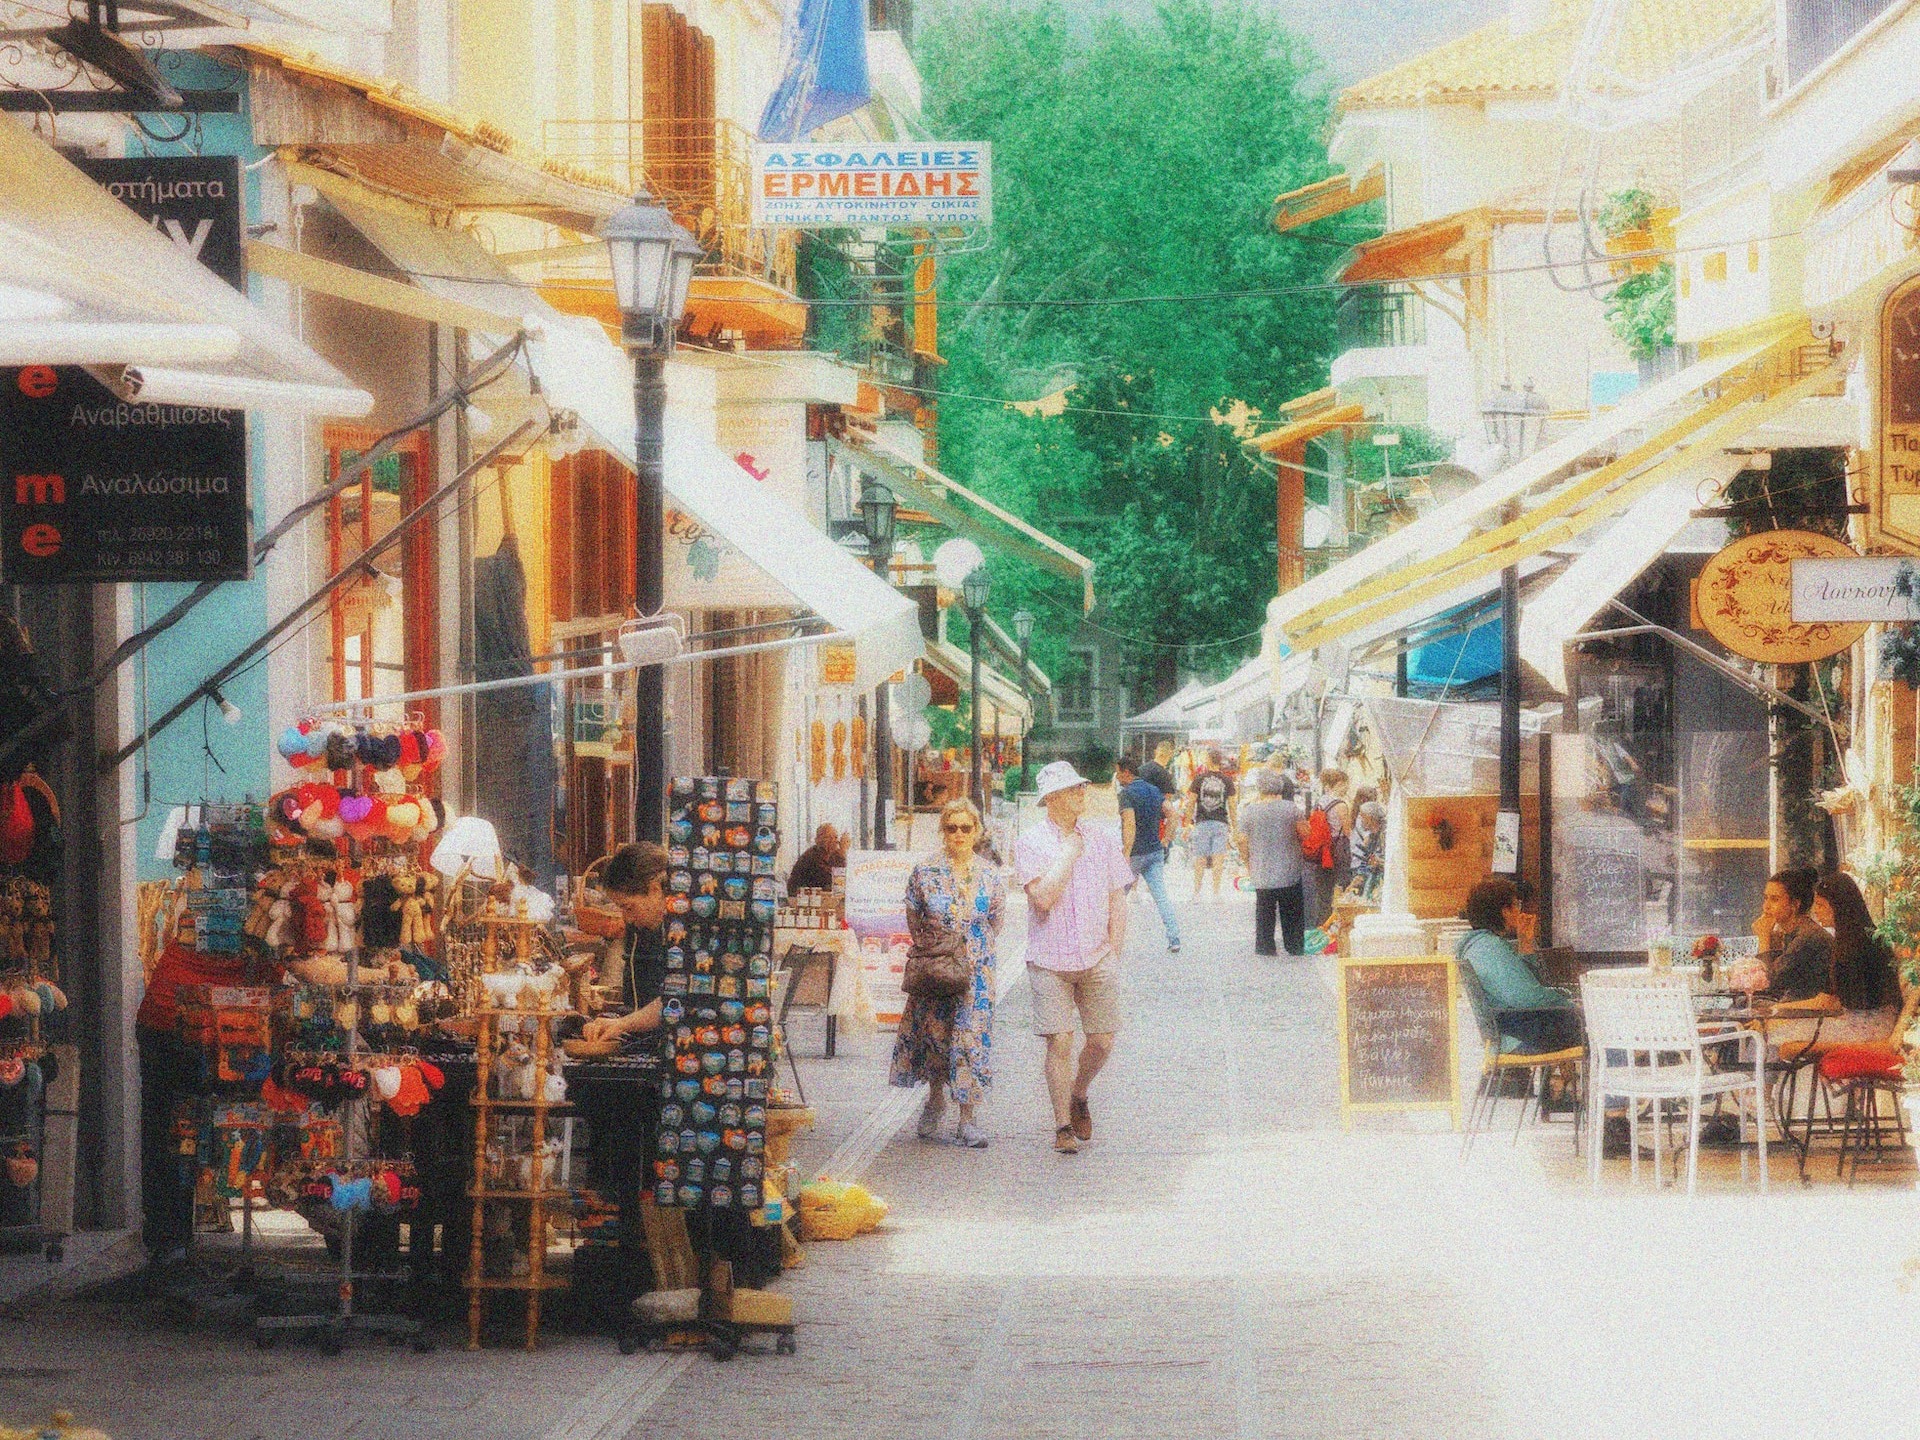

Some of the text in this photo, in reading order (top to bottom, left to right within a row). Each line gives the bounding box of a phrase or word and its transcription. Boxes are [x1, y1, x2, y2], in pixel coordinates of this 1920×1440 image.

[765, 151, 979, 167] ΑΣΦΑΛΕΙΕΣ
[103, 175, 226, 204] στήματα
[764, 172, 980, 197] ΕΡΜΕΙΔΗΣ
[815, 201, 918, 210] ΑΥΤΟΚΙΝΗΤΟΥ
[930, 200, 980, 209] ΟΙΚΙΑΣ
[765, 213, 980, 223] ΓΕΝΙΚΕΣ ΠΑΝΤΟΣ ΤΥΠΟΥ
[79, 472, 231, 500] Αναλώσιμα
[196, 549, 221, 565] 130
